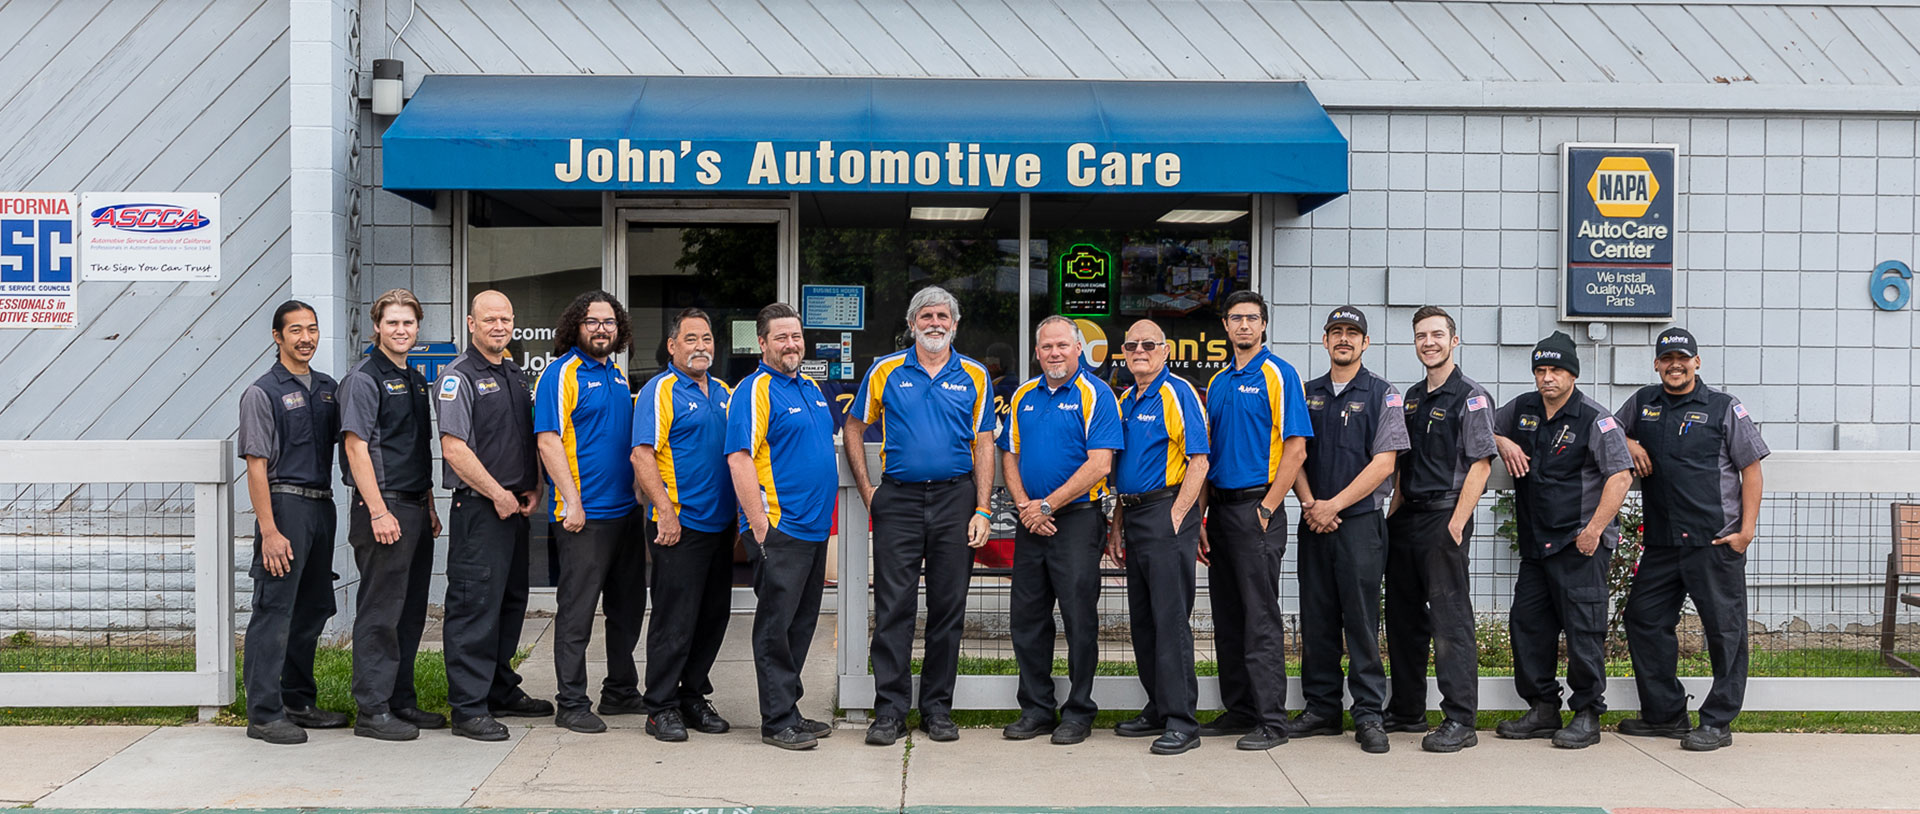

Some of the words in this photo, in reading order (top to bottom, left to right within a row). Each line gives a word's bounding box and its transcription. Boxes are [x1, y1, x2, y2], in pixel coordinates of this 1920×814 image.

[554, 138, 722, 185] John's
[747, 140, 1041, 188] Automotive
[1066, 142, 1181, 187] Care
[1599, 174, 1648, 201] NAPA
[91, 207, 206, 228] ASCCA
[1577, 220, 1668, 239] AutoCare
[0, 219, 72, 282] SC
[1590, 240, 1655, 259] Center
[90, 264, 110, 272] The
[113, 264, 136, 274] Sign
[138, 263, 158, 272] You
[160, 264, 182, 272] Can
[184, 264, 212, 273] Trust
[1597, 271, 1615, 283] We
[1616, 271, 1646, 283] Install
[1586, 283, 1623, 297] Quality
[1624, 284, 1656, 295] NAPA
[1869, 260, 1912, 311] 6
[56, 299, 66, 310] in
[1606, 296, 1635, 307] Parts
[0, 312, 29, 322] OTIVE
[31, 312, 74, 323] SERVICE
